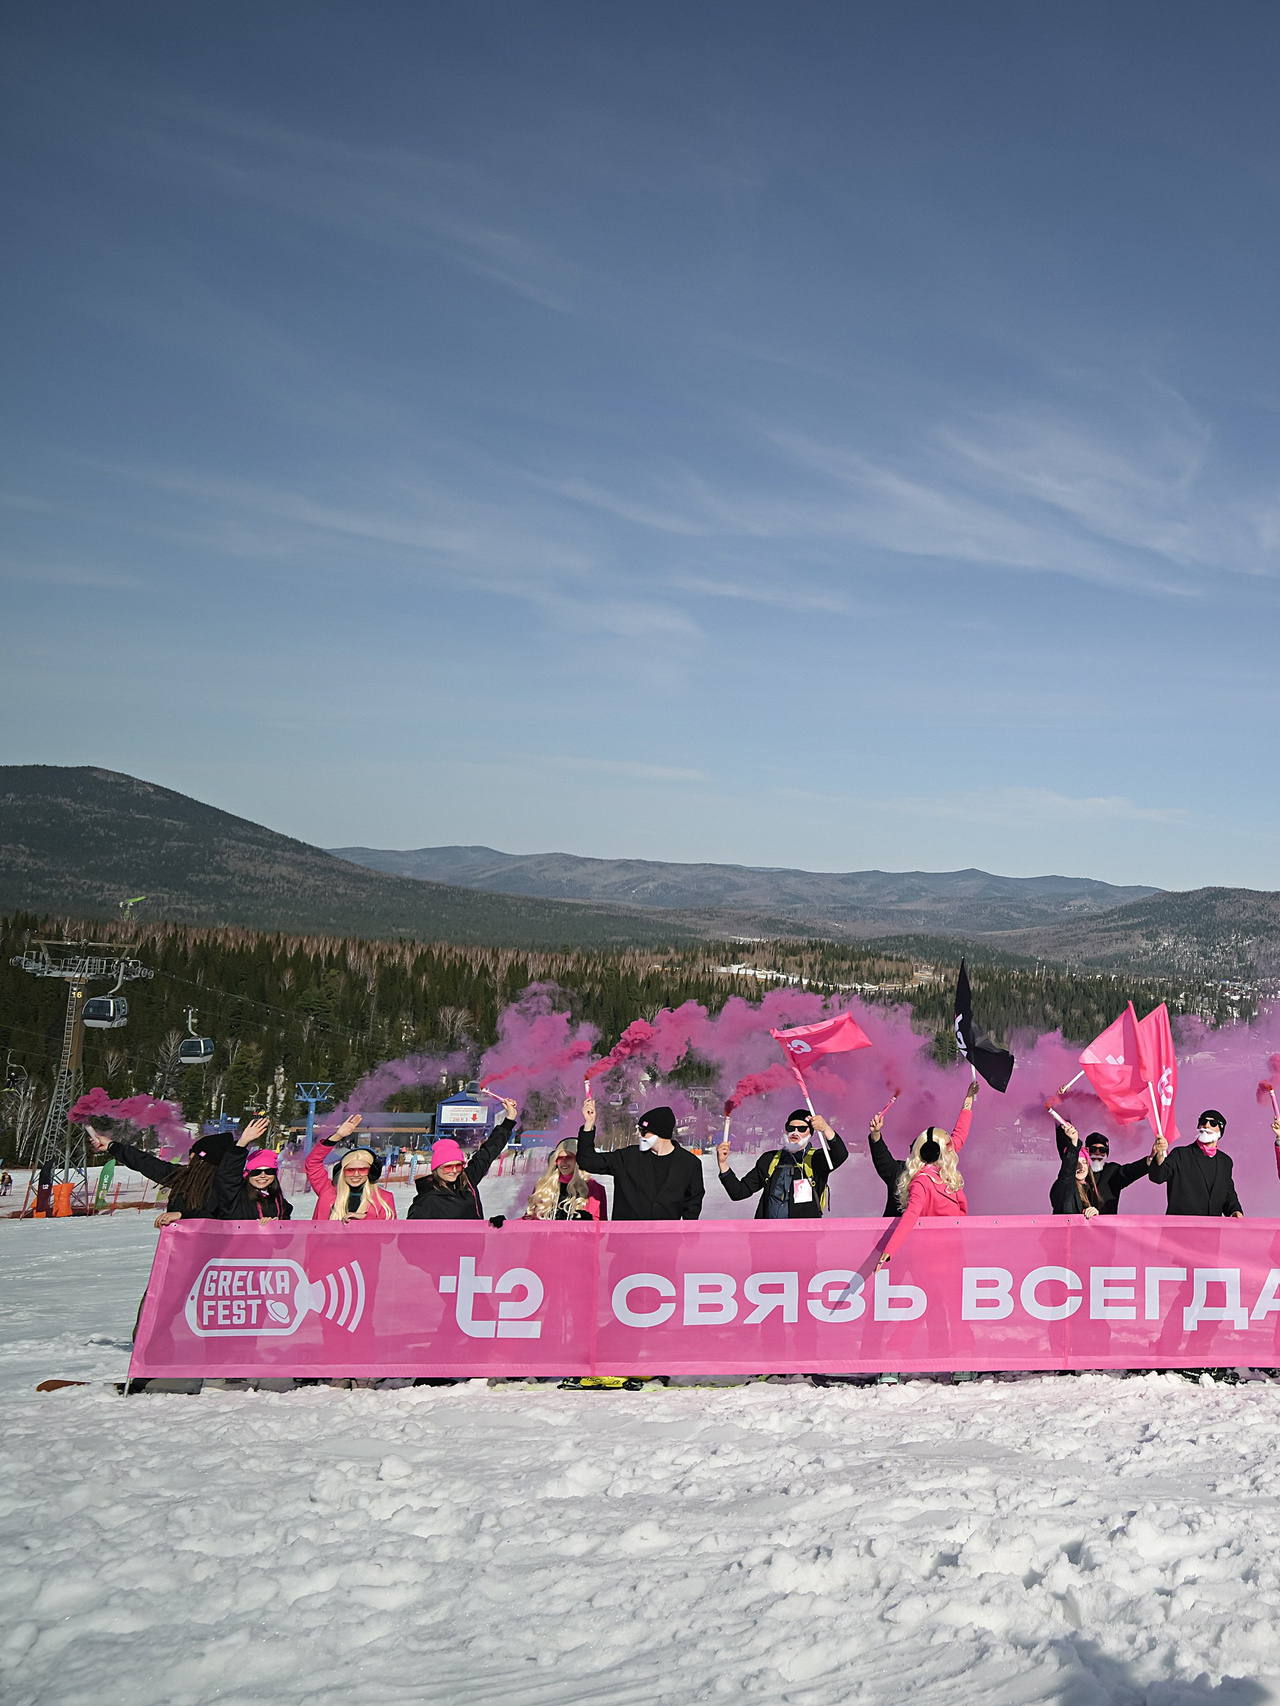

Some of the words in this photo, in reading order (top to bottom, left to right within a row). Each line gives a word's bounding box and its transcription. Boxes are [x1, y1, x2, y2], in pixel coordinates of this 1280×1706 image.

[71, 991, 83, 999] 16
[204, 1270, 290, 1297] GRELKA
[438, 1256, 544, 1339] t2
[611, 1268, 928, 1328] СВЯЗЬ
[203, 1299, 262, 1326] FEST
